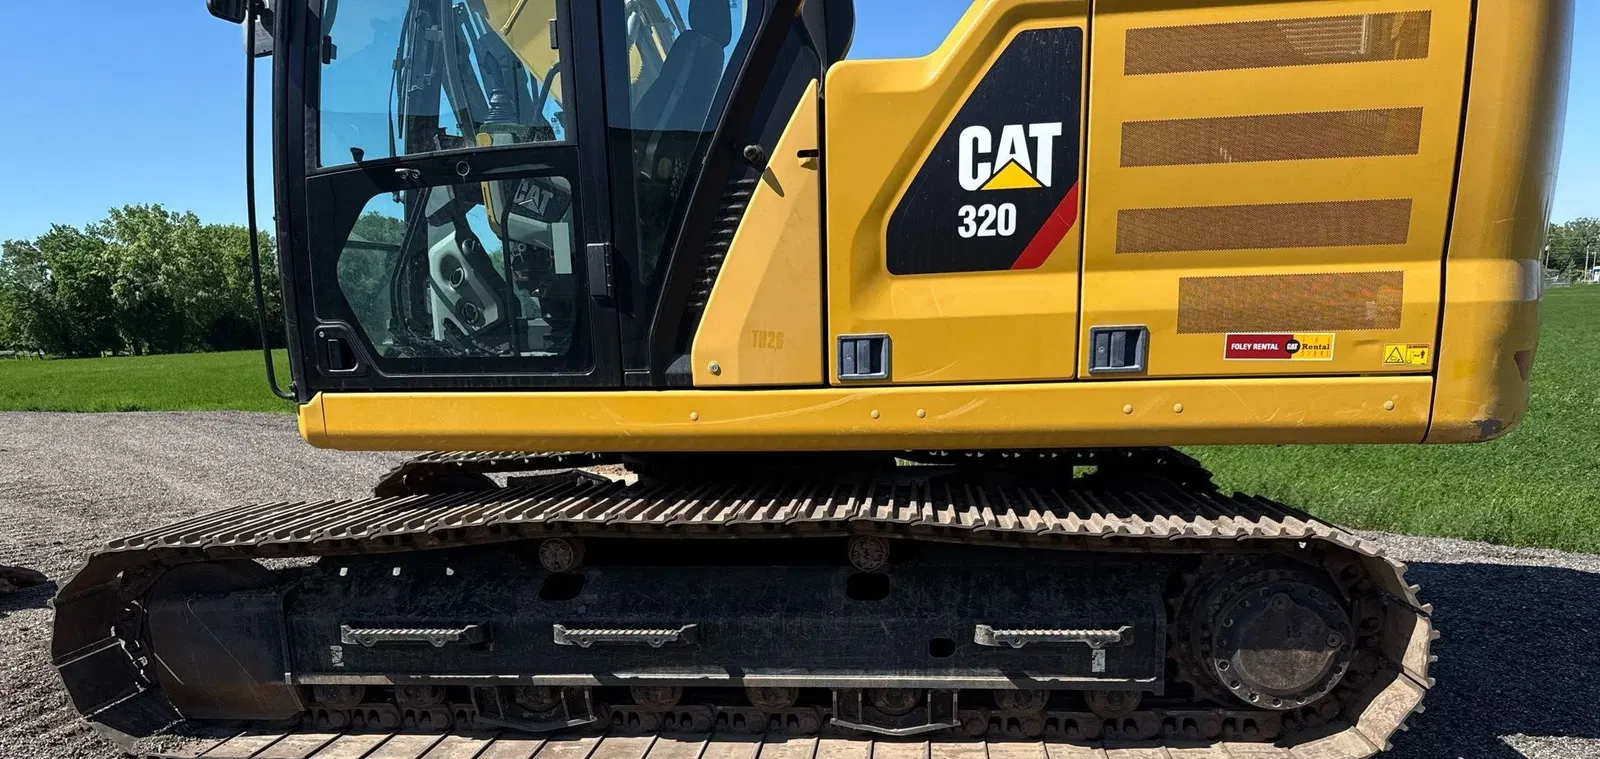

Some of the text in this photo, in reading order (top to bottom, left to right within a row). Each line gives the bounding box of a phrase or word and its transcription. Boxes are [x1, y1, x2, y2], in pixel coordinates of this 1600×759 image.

[958, 122, 1062, 191] CAT
[513, 178, 554, 216] CAT
[957, 202, 1017, 238] 320
